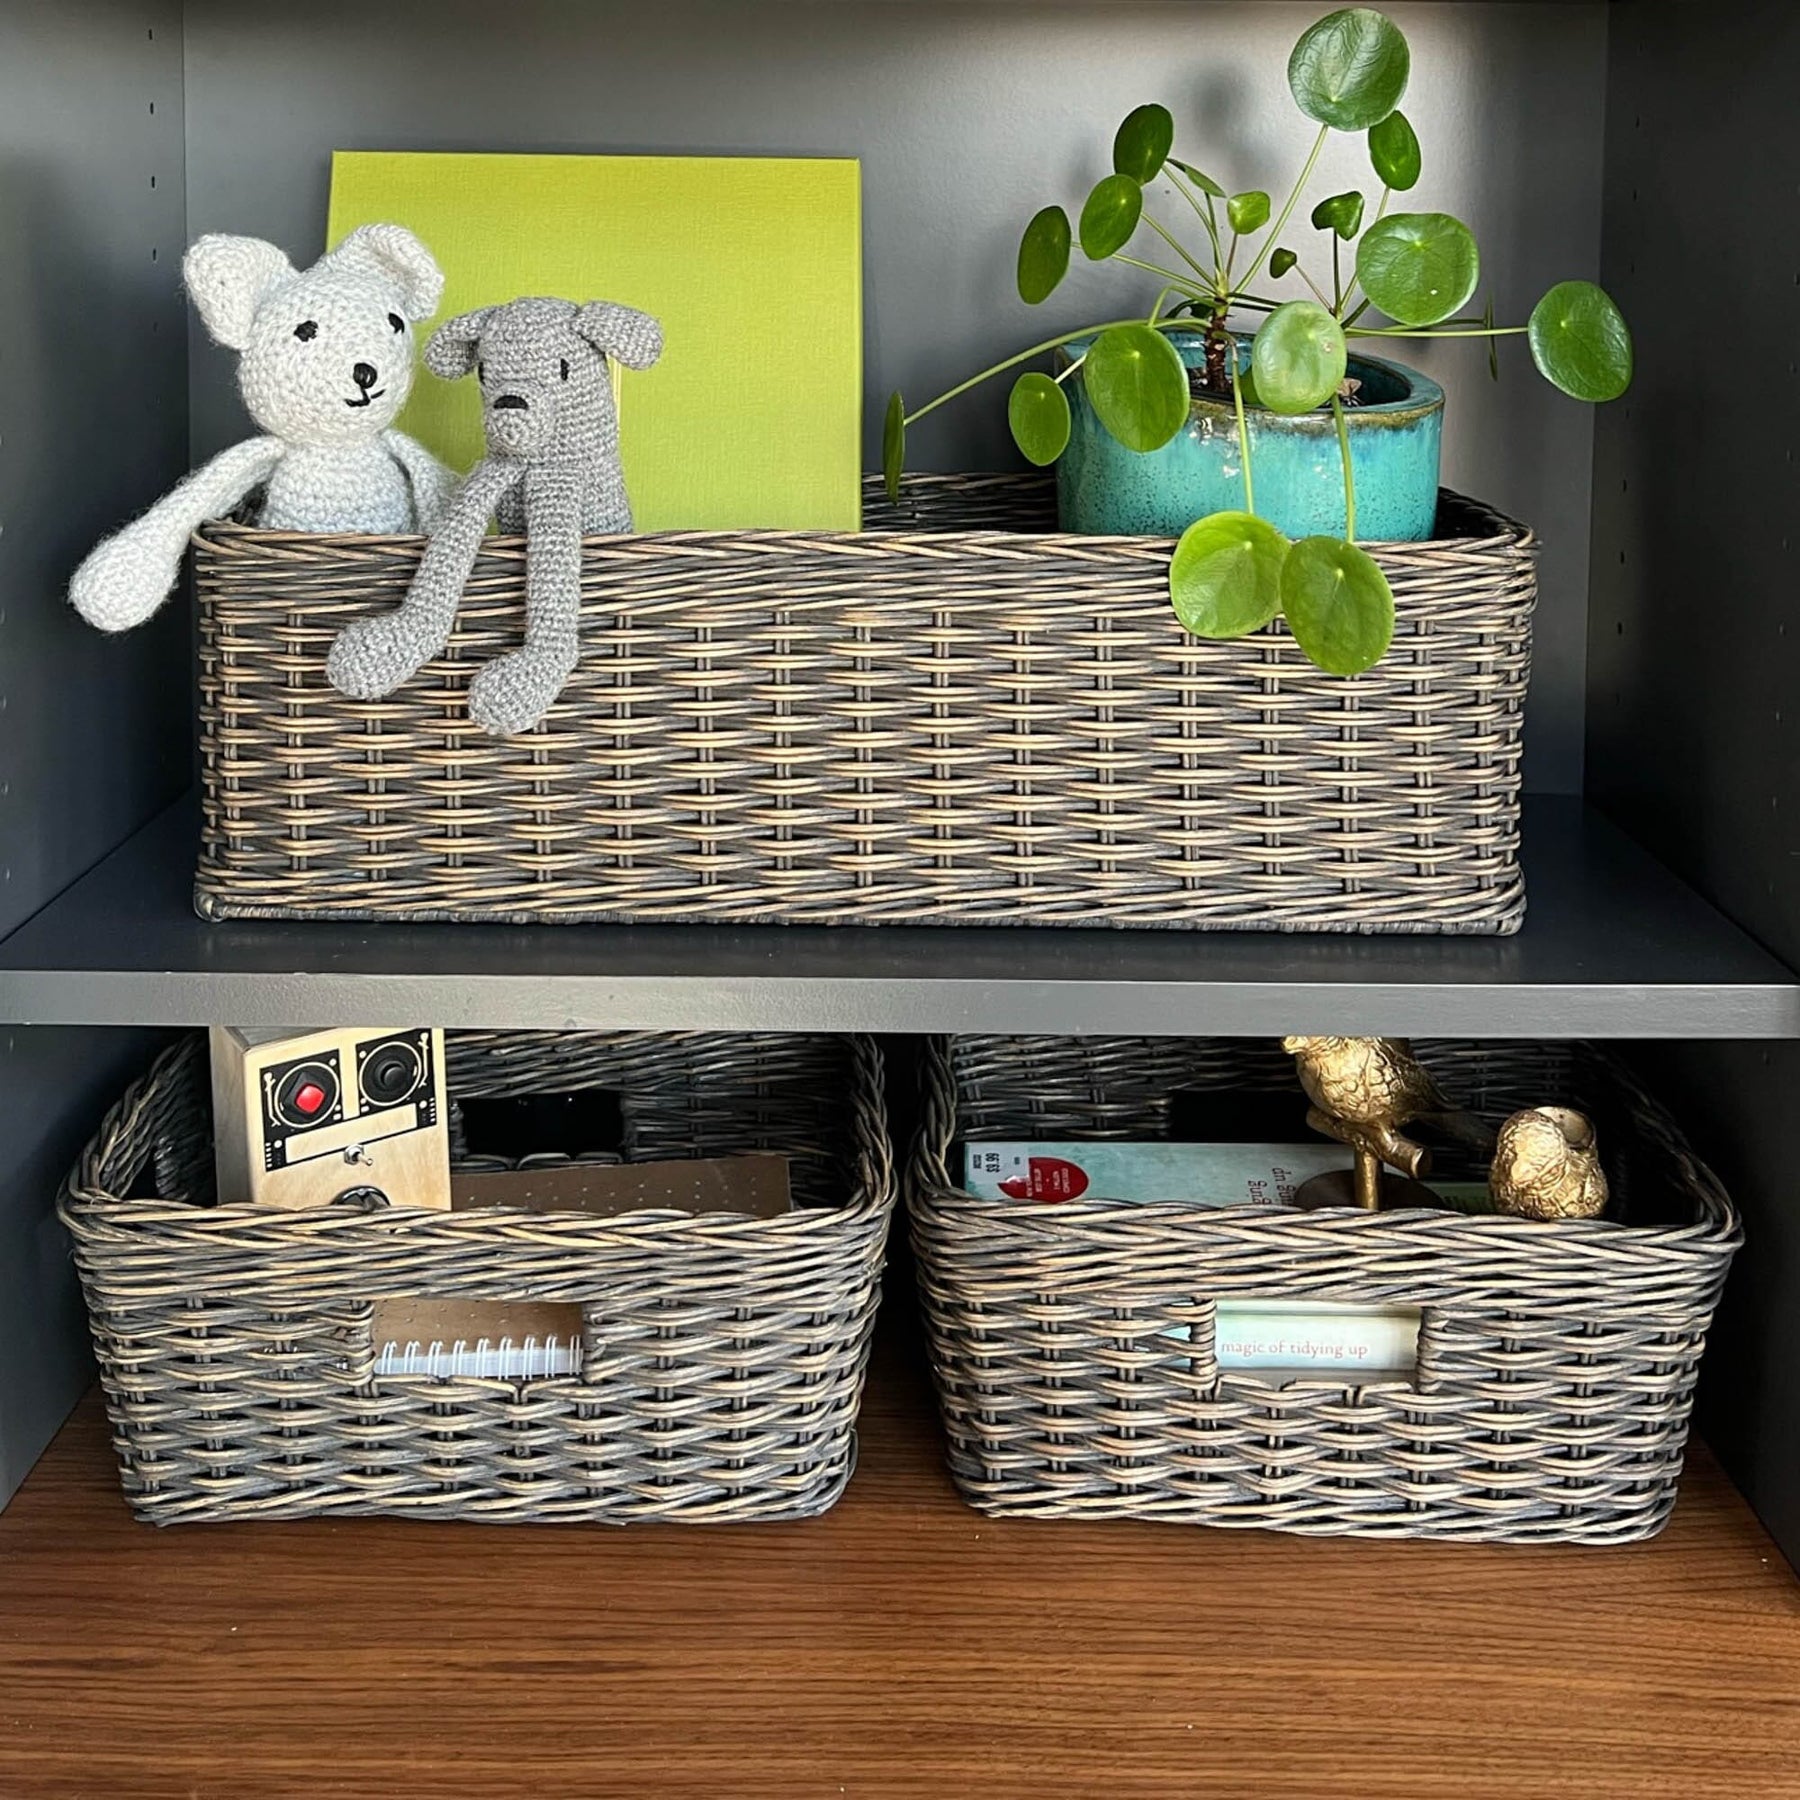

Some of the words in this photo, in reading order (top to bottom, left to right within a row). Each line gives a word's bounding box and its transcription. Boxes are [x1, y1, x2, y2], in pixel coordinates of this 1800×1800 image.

[985, 1152, 1000, 1173] $9.99
[1272, 1167, 1292, 1181] up
[1221, 1340, 1264, 1357] magic
[1268, 1339, 1284, 1354] of
[1290, 1340, 1343, 1359] tidying
[1348, 1345, 1369, 1359] up
